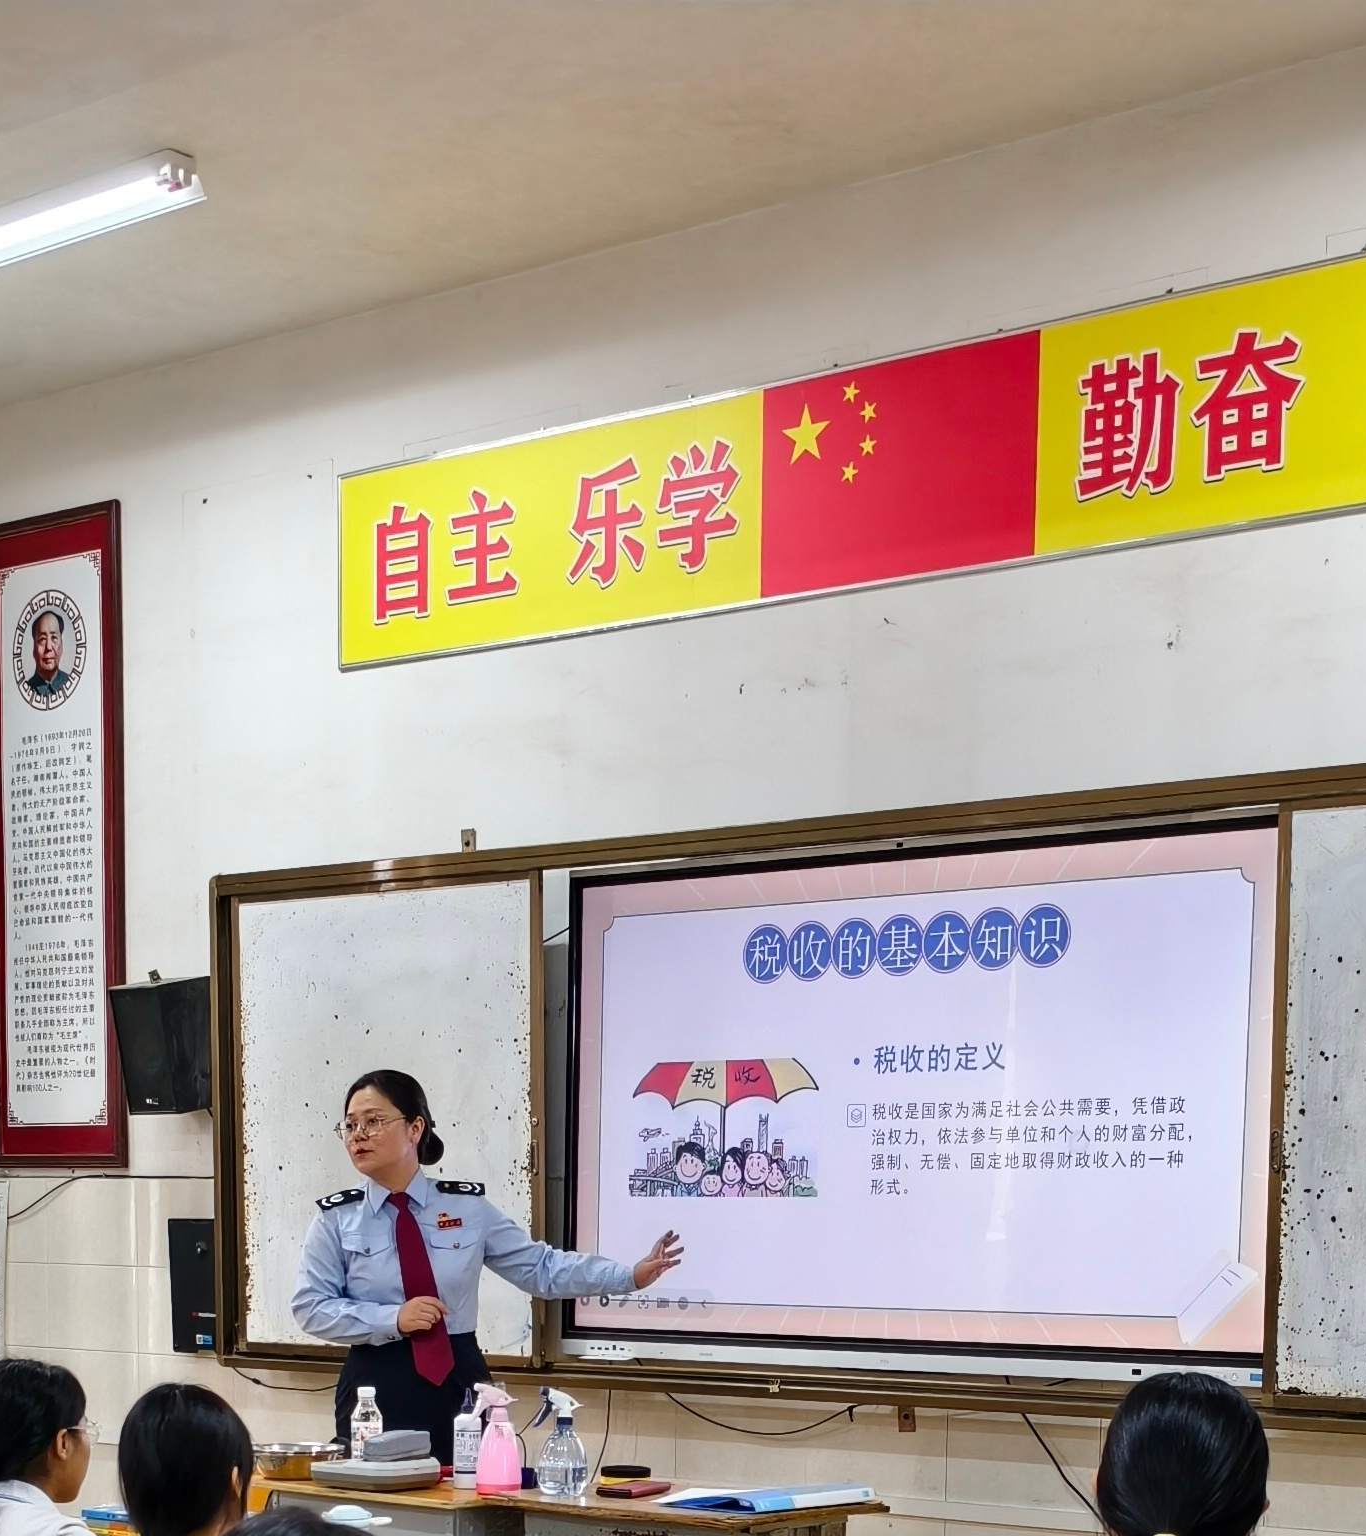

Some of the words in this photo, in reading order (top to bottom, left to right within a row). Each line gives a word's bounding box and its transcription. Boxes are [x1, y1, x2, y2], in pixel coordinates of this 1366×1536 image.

[374, 490, 519, 620] 自主
[568, 437, 741, 587] 乐学
[1075, 333, 1302, 500] 勤奋
[747, 913, 1065, 980] 税收的基本知识
[873, 1042, 1005, 1075] 税收的定义
[691, 1065, 716, 1087] 税
[733, 1064, 760, 1085] 收
[871, 1096, 1186, 1121] 税收是国家为满足社会公共需要，凭借政
[871, 1123, 1194, 1146] 治权力，依法参与单位和个人的财富分配，
[870, 1150, 1184, 1171] 强制、无偿、固定地取得财政收入的一种
[870, 1178, 910, 1196] 形式。
